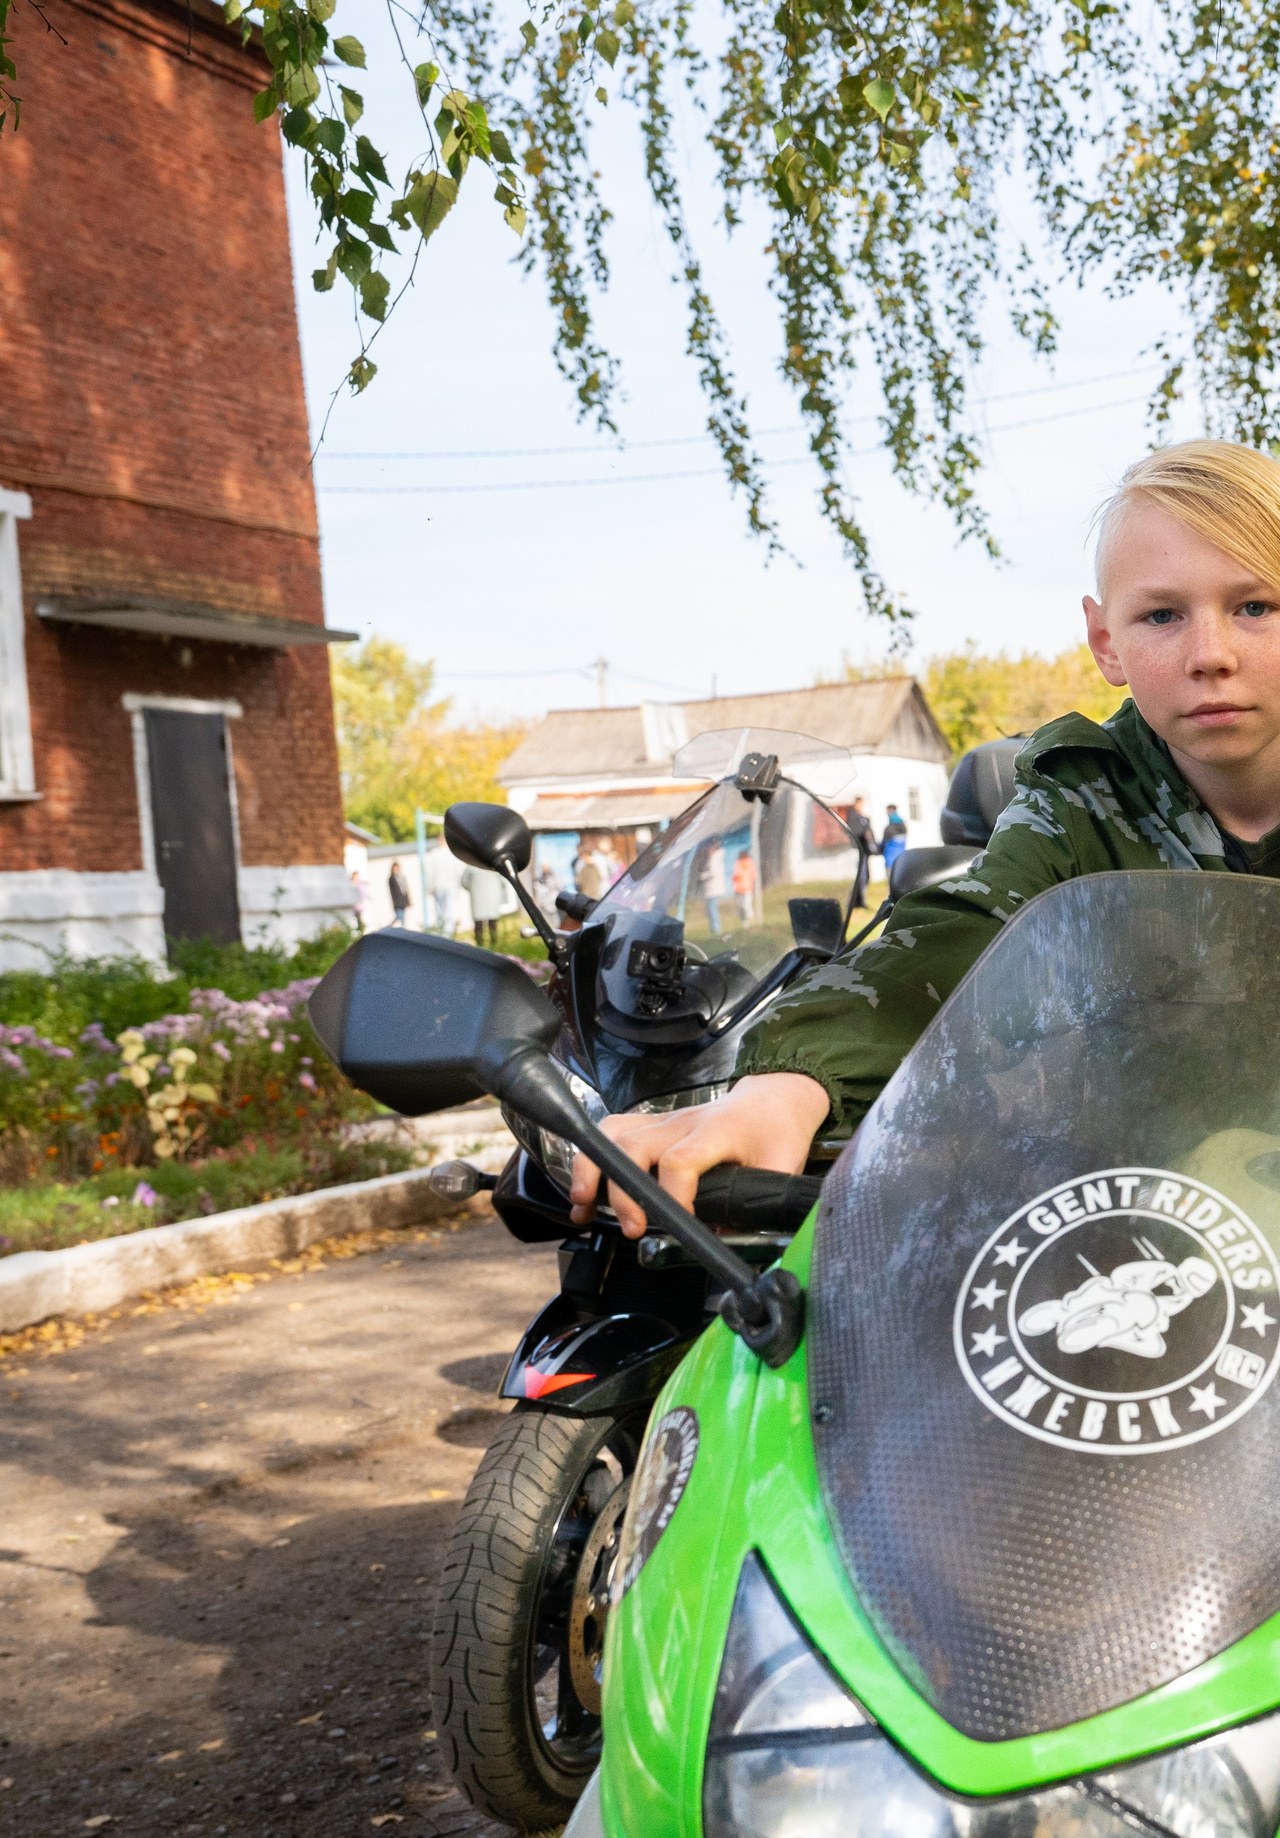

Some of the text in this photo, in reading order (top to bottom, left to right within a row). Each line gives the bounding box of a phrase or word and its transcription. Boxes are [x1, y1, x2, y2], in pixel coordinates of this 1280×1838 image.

[1026, 1176, 1273, 1290] GENT RIDERS
[980, 1355, 1181, 1442] ИЖЕВСК
